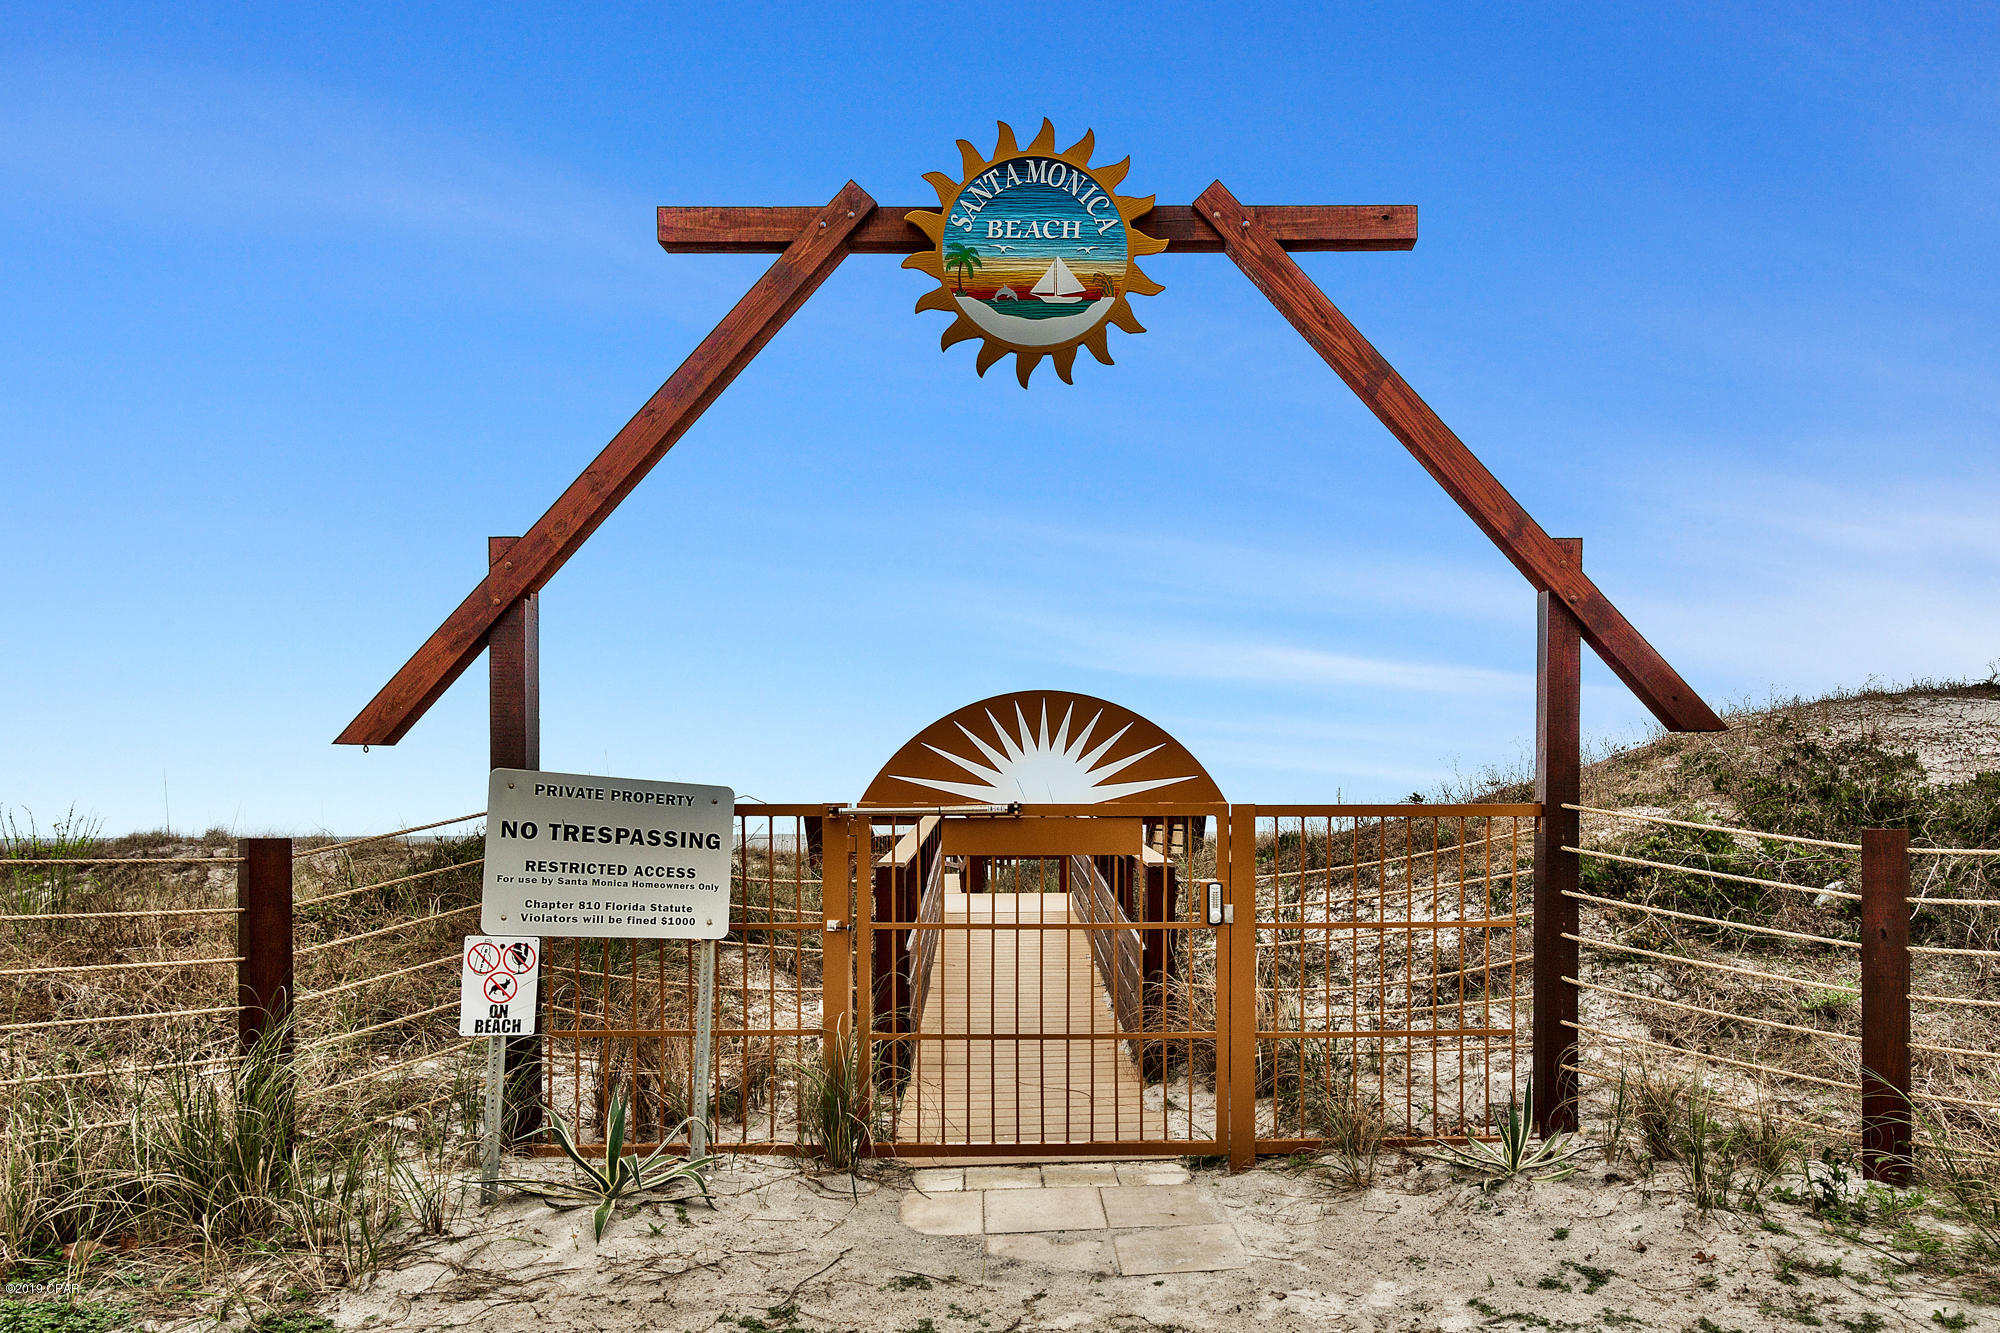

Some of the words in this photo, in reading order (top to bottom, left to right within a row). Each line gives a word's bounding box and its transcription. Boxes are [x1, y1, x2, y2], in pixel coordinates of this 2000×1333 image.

[950, 163, 1022, 233] SANTA
[1025, 159, 1120, 235] MONICA
[986, 220, 1082, 239] BEACH
[535, 784, 604, 800] PRIVATE
[611, 789, 695, 806] PROPERTY
[501, 820, 538, 839] NO
[549, 823, 721, 850] TRESPASSING
[525, 860, 627, 875] RESTRICTED
[634, 865, 696, 878] ACCESS
[497, 875, 514, 883] For
[542, 876, 554, 886] by
[557, 877, 588, 886] Santa
[592, 879, 628, 887] Monica
[632, 880, 695, 889] Homeowners
[698, 883, 719, 892] Only
[525, 900, 574, 911] Chapter
[578, 901, 600, 910] 810
[606, 902, 645, 911] Florida
[650, 903, 693, 913] Statute
[520, 913, 578, 923] Violators
[583, 914, 603, 924] will
[609, 915, 622, 924] be
[627, 916, 656, 925] fined
[661, 916, 695, 926] $1000
[489, 1004, 508, 1018] ON
[474, 1019, 521, 1033] BEACH
